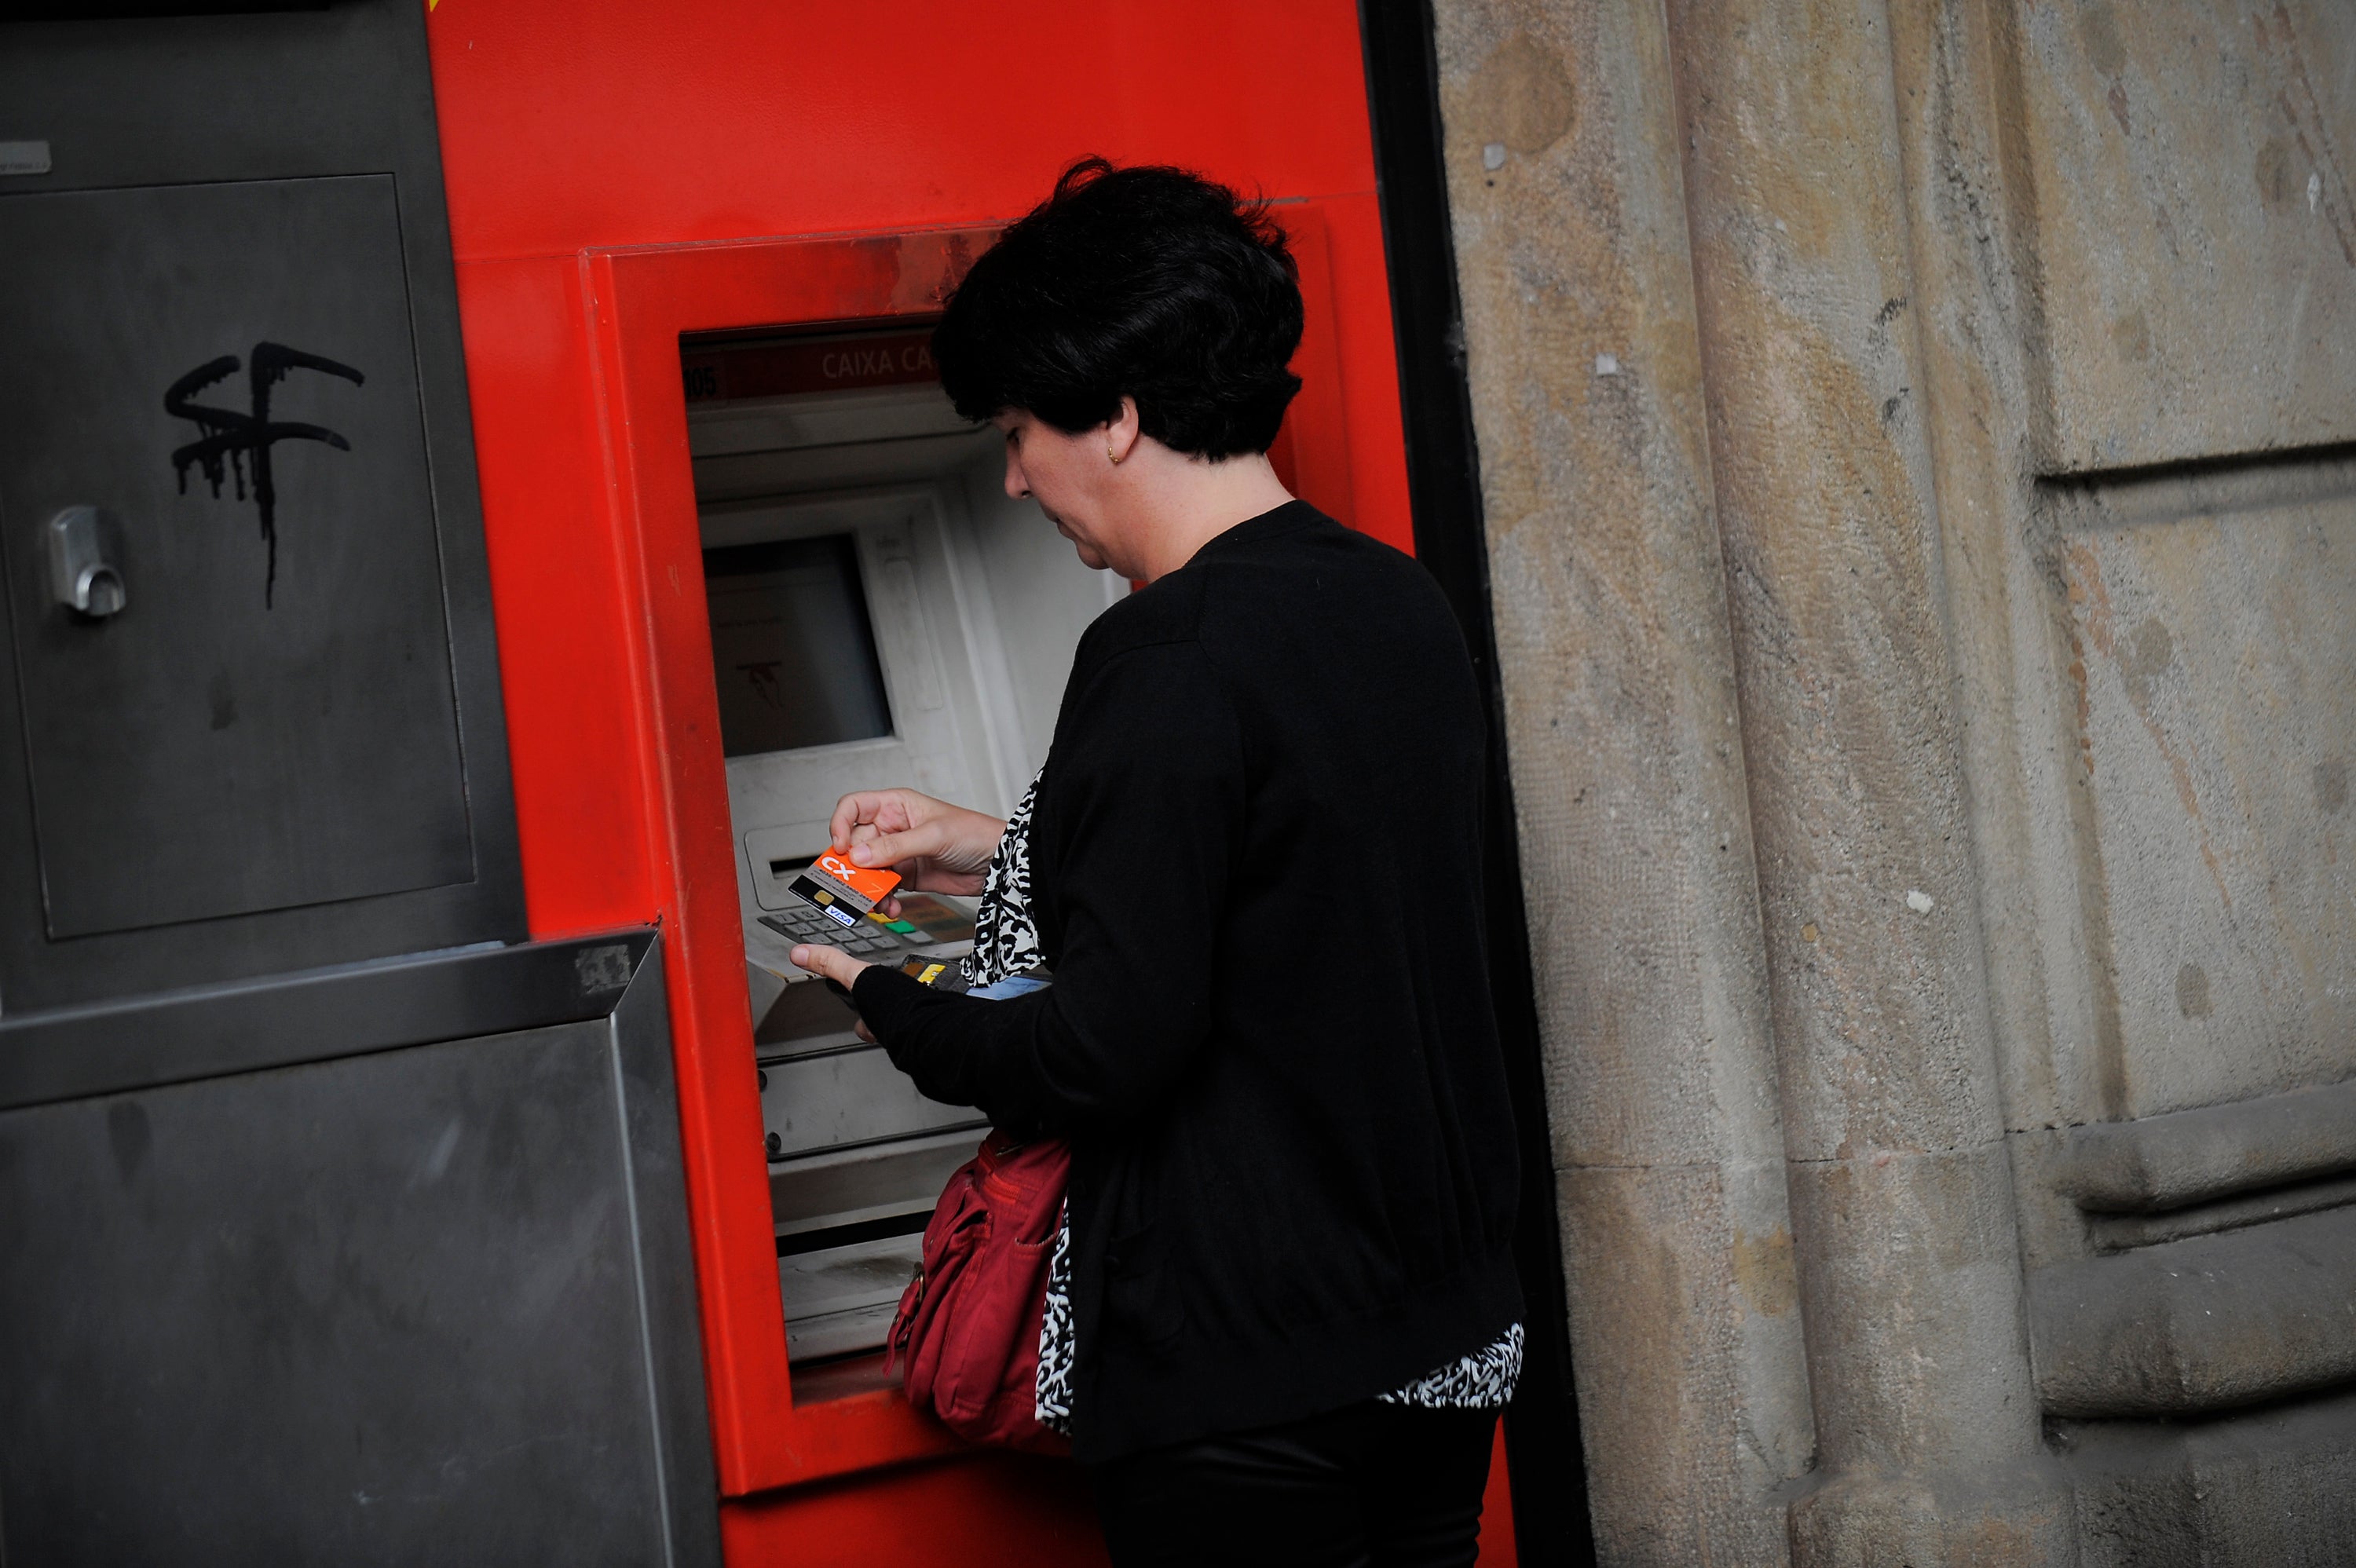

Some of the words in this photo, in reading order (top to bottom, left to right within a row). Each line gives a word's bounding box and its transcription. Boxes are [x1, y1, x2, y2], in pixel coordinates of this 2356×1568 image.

[821, 351, 894, 378] CAIXA
[902, 345, 937, 372] CA
[821, 856, 857, 881] CX
[829, 908, 851, 924] VISA
